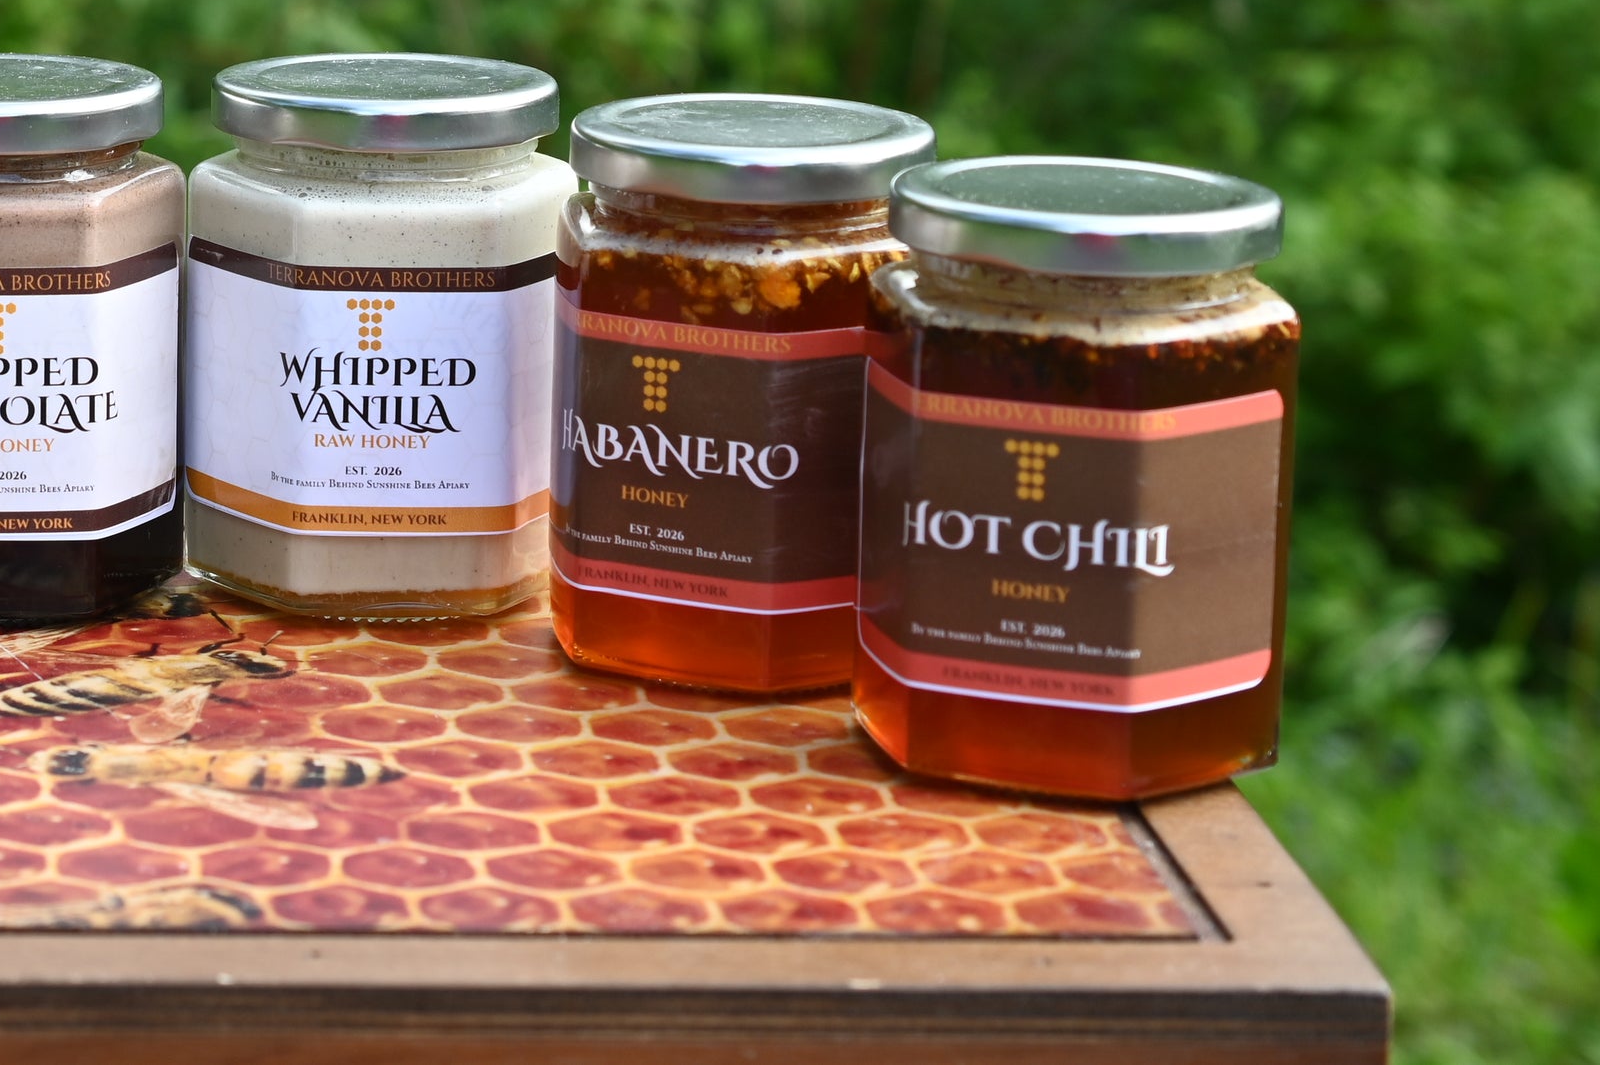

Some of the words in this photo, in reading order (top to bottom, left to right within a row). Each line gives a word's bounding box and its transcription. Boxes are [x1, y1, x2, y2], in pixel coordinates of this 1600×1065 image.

[12, 270, 112, 292] BROTHERS
[267, 262, 385, 288] TERRANOVA
[390, 270, 496, 288] BROTHERS
[673, 325, 792, 354] BROTHERS
[280, 347, 477, 392] WHIPPED
[290, 388, 462, 434] VANILLA
[1051, 406, 1177, 433] BROTHERS
[313, 433, 356, 448] RAW
[360, 434, 431, 449] HONEY
[562, 408, 800, 489] HABANERO
[345, 465, 368, 476] EST.
[373, 466, 402, 477] 2026
[39, 483, 62, 494] BEES
[63, 482, 95, 493] APIARY
[329, 478, 364, 489] BEHIND
[366, 479, 411, 490] SUNSHINE
[414, 479, 436, 490] BEES
[438, 479, 470, 490] APIARY
[621, 485, 689, 509] HONEY
[32, 517, 74, 530] YORK
[291, 510, 368, 526] FRANKLIN,
[371, 513, 404, 525] NEW
[406, 513, 447, 526] YORK
[629, 523, 652, 536] EST.
[656, 527, 685, 542] 2026
[902, 500, 1012, 554] HOT
[1021, 519, 1175, 577] CHILI
[653, 575, 686, 591] NEW
[690, 583, 728, 598] YORK
[991, 579, 1070, 604] HONEY
[1032, 622, 1066, 639] 2026
